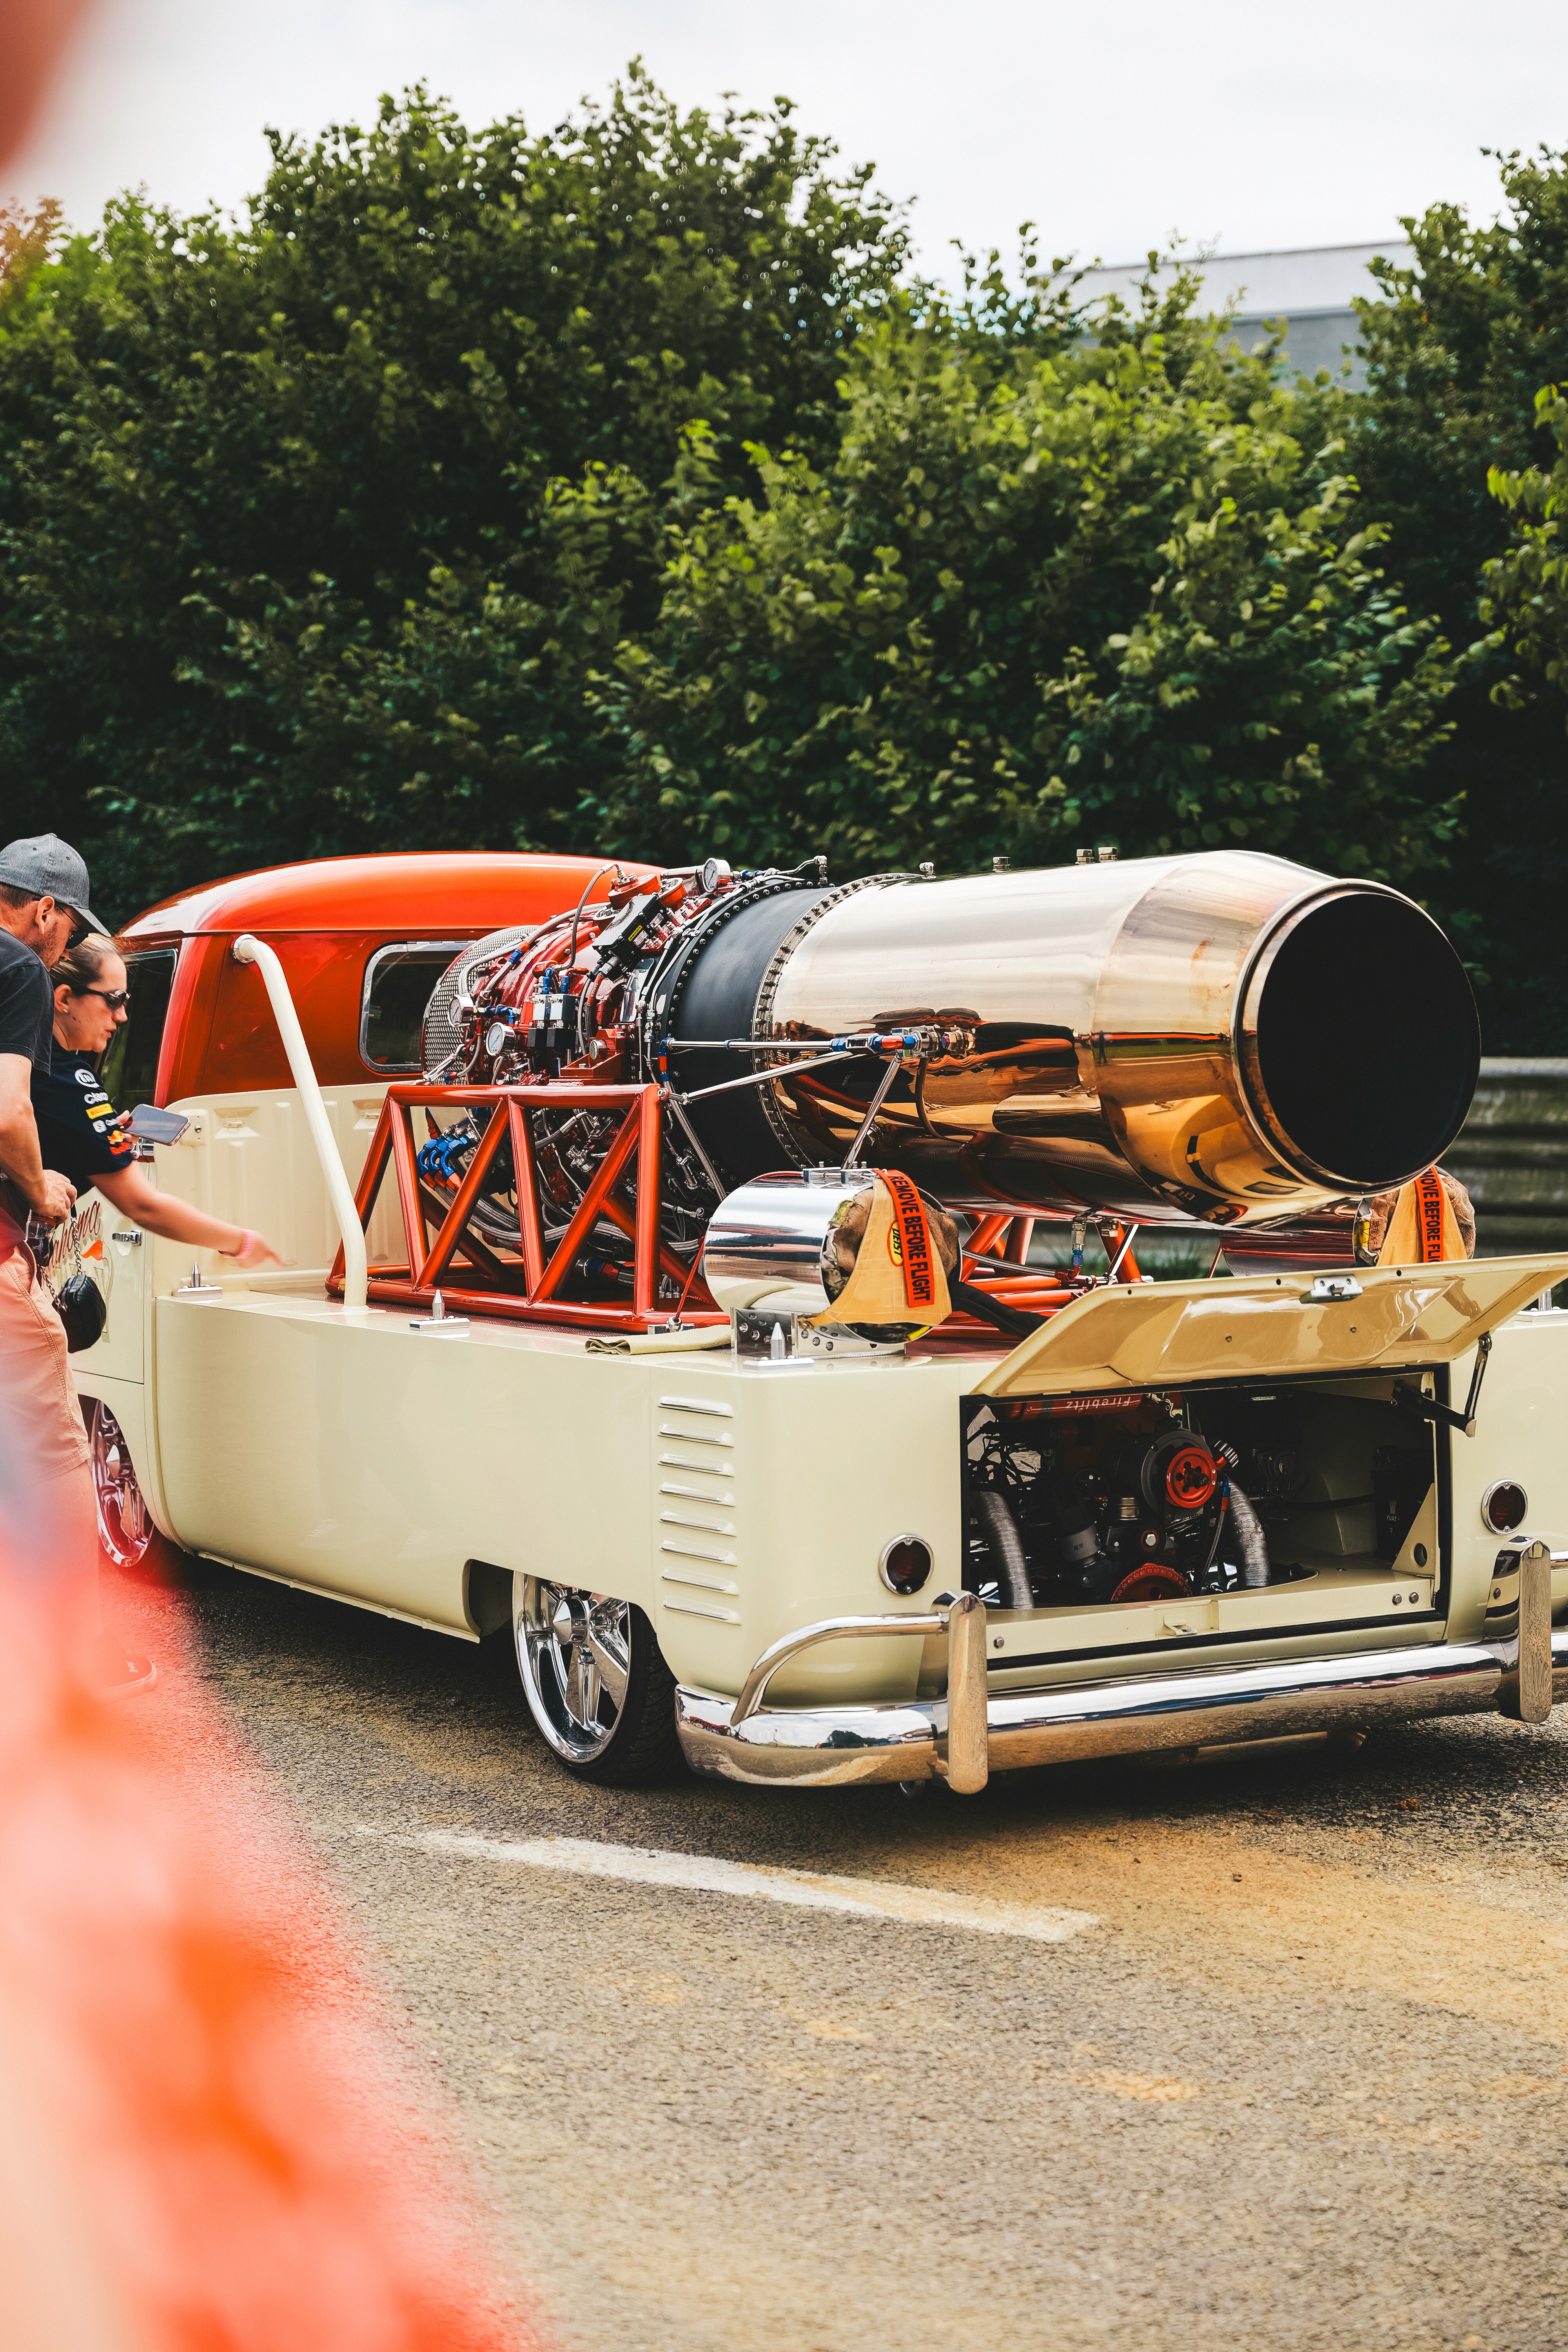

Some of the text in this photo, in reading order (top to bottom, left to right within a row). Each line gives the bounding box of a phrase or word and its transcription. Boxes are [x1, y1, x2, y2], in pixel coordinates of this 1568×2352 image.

[590, 982, 599, 997] DANGER
[889, 1176, 931, 1301] REMOVE BEFORE FLIGHT
[1419, 1169, 1440, 1263] MOVE BEFORE FLI
[1065, 1396, 1131, 1411] Fireblitz
